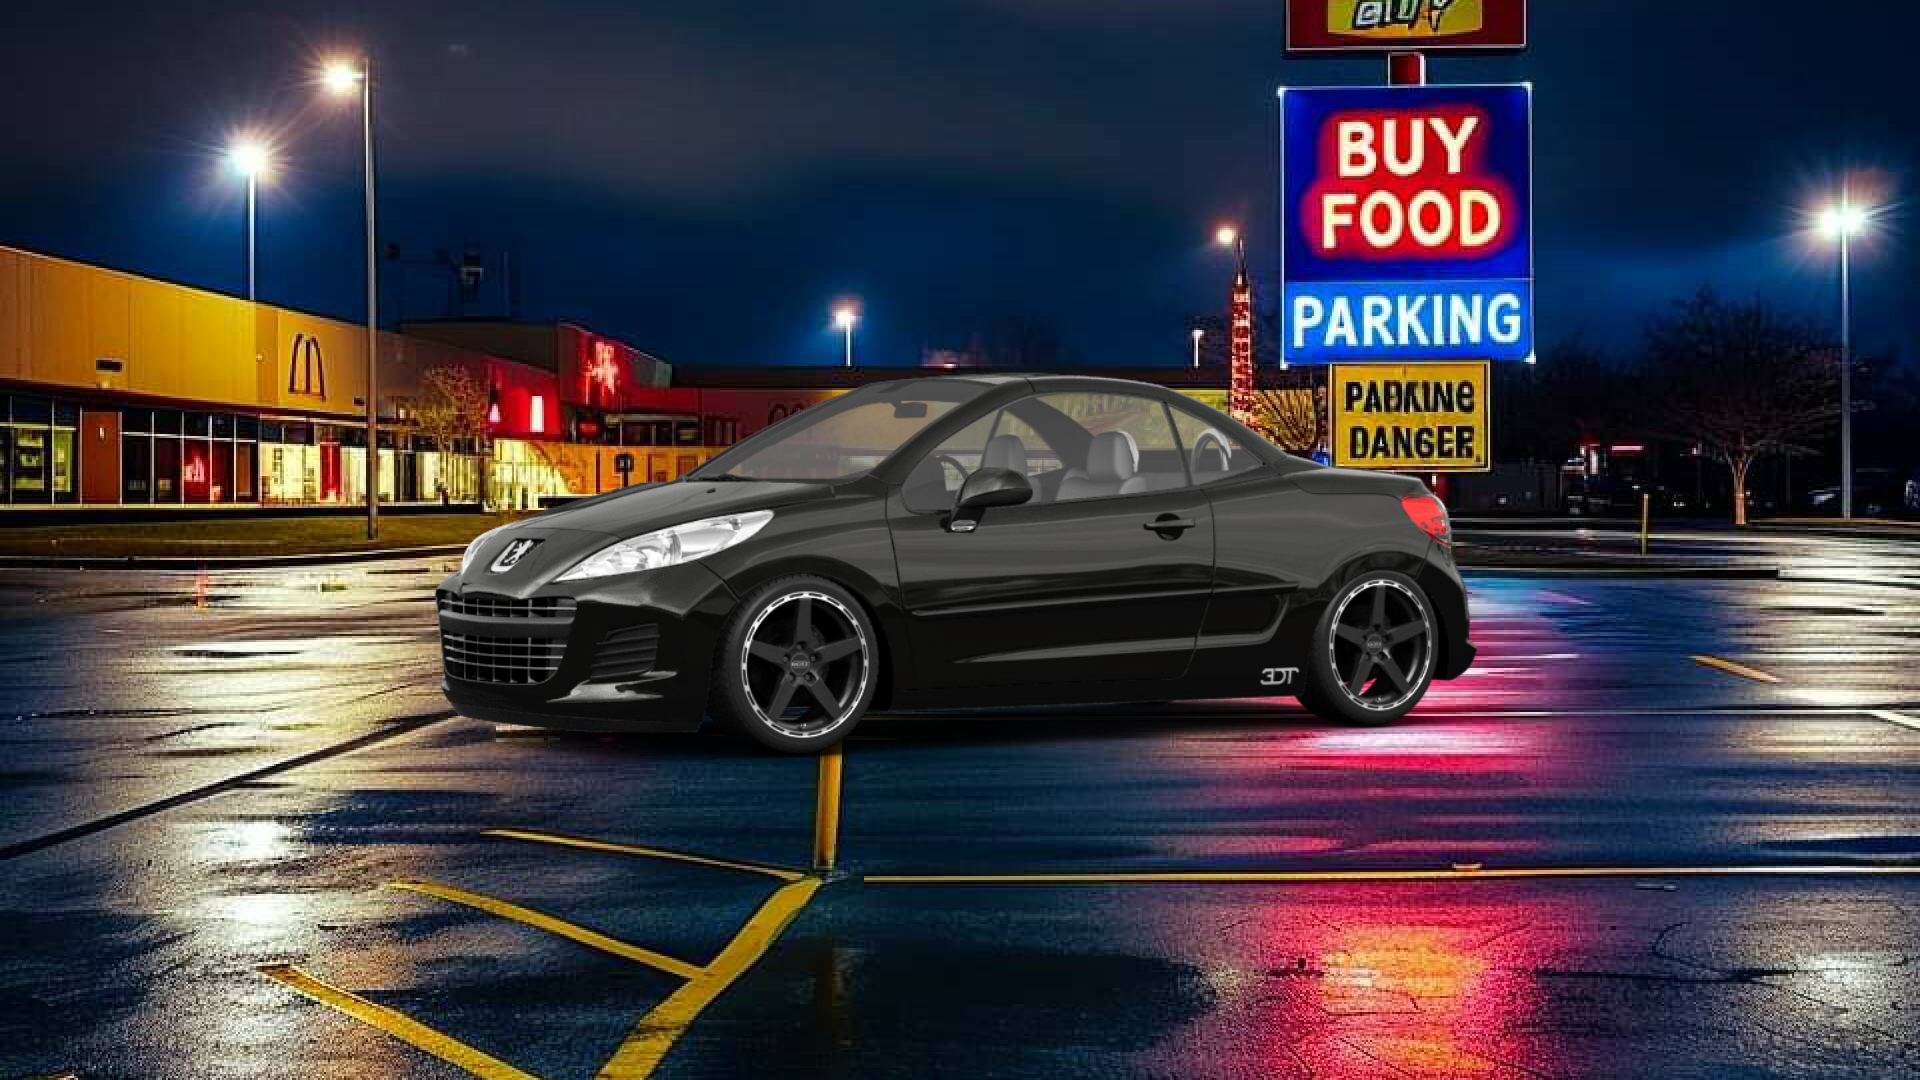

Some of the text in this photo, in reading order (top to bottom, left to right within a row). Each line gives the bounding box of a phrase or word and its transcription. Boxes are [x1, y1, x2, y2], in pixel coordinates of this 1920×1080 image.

[1338, 116, 1479, 178] BUY
[1321, 189, 1501, 249] FOOD
[1293, 293, 1521, 348] PARKING
